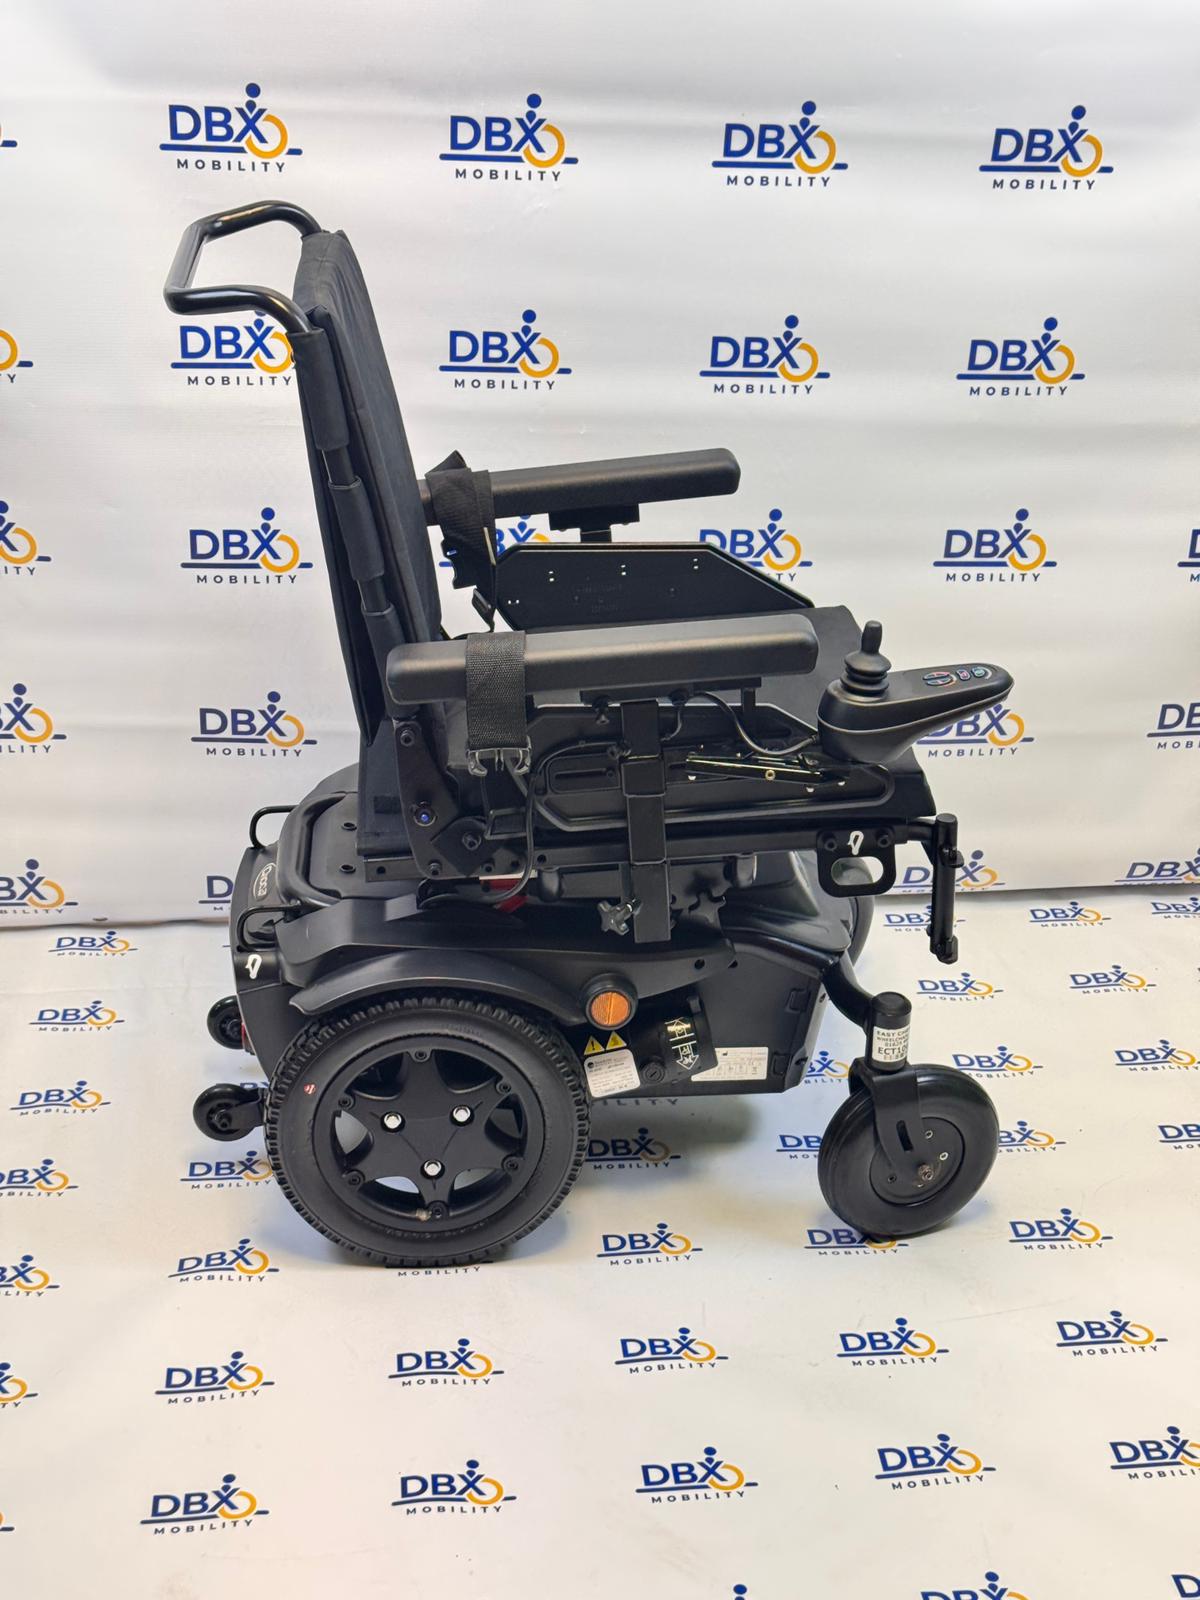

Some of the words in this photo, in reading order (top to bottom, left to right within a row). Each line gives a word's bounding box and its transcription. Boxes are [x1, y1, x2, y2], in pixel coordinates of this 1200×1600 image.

[168, 103, 268, 144] DBX
[449, 115, 548, 153] DBX
[723, 123, 820, 159] DBX
[990, 128, 1090, 162] DBX
[176, 157, 286, 172] MOBILITY
[455, 167, 562, 182] MOBILITY
[726, 174, 831, 188] MOBILITY
[992, 178, 1096, 190] MOBILITY
[180, 324, 274, 360] DBX
[448, 330, 542, 364] DBX
[710, 335, 803, 369] DBX
[967, 339, 1060, 372] DBX
[187, 375, 292, 386] MOBILITY
[454, 378, 556, 390] MOBILITY
[713, 383, 814, 395] MOBILITY
[969, 385, 1068, 396] MOBILITY
[189, 528, 281, 561] DBX
[943, 528, 1032, 559] DBX
[196, 574, 298, 585] MOBILITY
[945, 572, 1042, 582] MOBILITY
[200, 707, 287, 737] DBX
[205, 747, 302, 758] MOBILITY
[927, 747, 1019, 758] MOBILITY
[902, 865, 985, 885] DX
[0, 876, 48, 901] BX
[56, 936, 118, 949] DBX
[917, 978, 977, 993] DBX
[38, 1006, 103, 1022] DBX
[952, 1053, 1016, 1070] DBX
[1114, 1048, 1182, 1064] DBX
[1129, 1063, 1200, 1072] MOBILITY
[19, 1088, 90, 1106] DBX
[602, 1098, 681, 1106] ILITY
[20, 1107, 99, 1116] MOBILITY
[999, 1128, 1041, 1144] BX
[1158, 1123, 1200, 1140] DB
[590, 1137, 656, 1158] DBX
[779, 1135, 821, 1149] DB
[188, 1158, 261, 1177] DBX
[593, 1161, 671, 1170] MOBILITY
[0, 1168, 55, 1185] BX
[191, 1179, 271, 1190] MOBILITY
[1009, 1219, 1087, 1239] DBX
[603, 1232, 675, 1252] DBX
[1022, 1243, 1104, 1252] MOBILITY
[177, 1247, 255, 1273] DBX
[610, 1254, 692, 1266] MOBILITY
[818, 1247, 898, 1257] MOBILITY
[179, 1274, 265, 1283] MOBILITY
[398, 1265, 482, 1277] MOBILITY
[1055, 1319, 1142, 1341] DBX
[619, 1337, 702, 1358] DBX
[839, 1329, 921, 1352] DBX
[1072, 1344, 1158, 1357] MOBILITY
[396, 1351, 475, 1373] DBX
[629, 1361, 717, 1374] MOBILITY
[851, 1356, 938, 1367] MOBILITY
[164, 1362, 249, 1389] DBX
[401, 1378, 492, 1387] MOBILITY
[168, 1389, 261, 1405] MOBILITY
[1109, 1438, 1199, 1463] DBX
[877, 1445, 967, 1473] DBX
[640, 1460, 728, 1487] DBX
[1127, 1468, 1200, 1481] MOBILI
[400, 1473, 486, 1499] DBX
[891, 1474, 985, 1491] MOBILITY
[151, 1487, 241, 1517] DBX
[651, 1490, 746, 1504] MOBILITY
[406, 1504, 502, 1516] MOBILITY
[154, 1518, 253, 1535] MOBILITY
